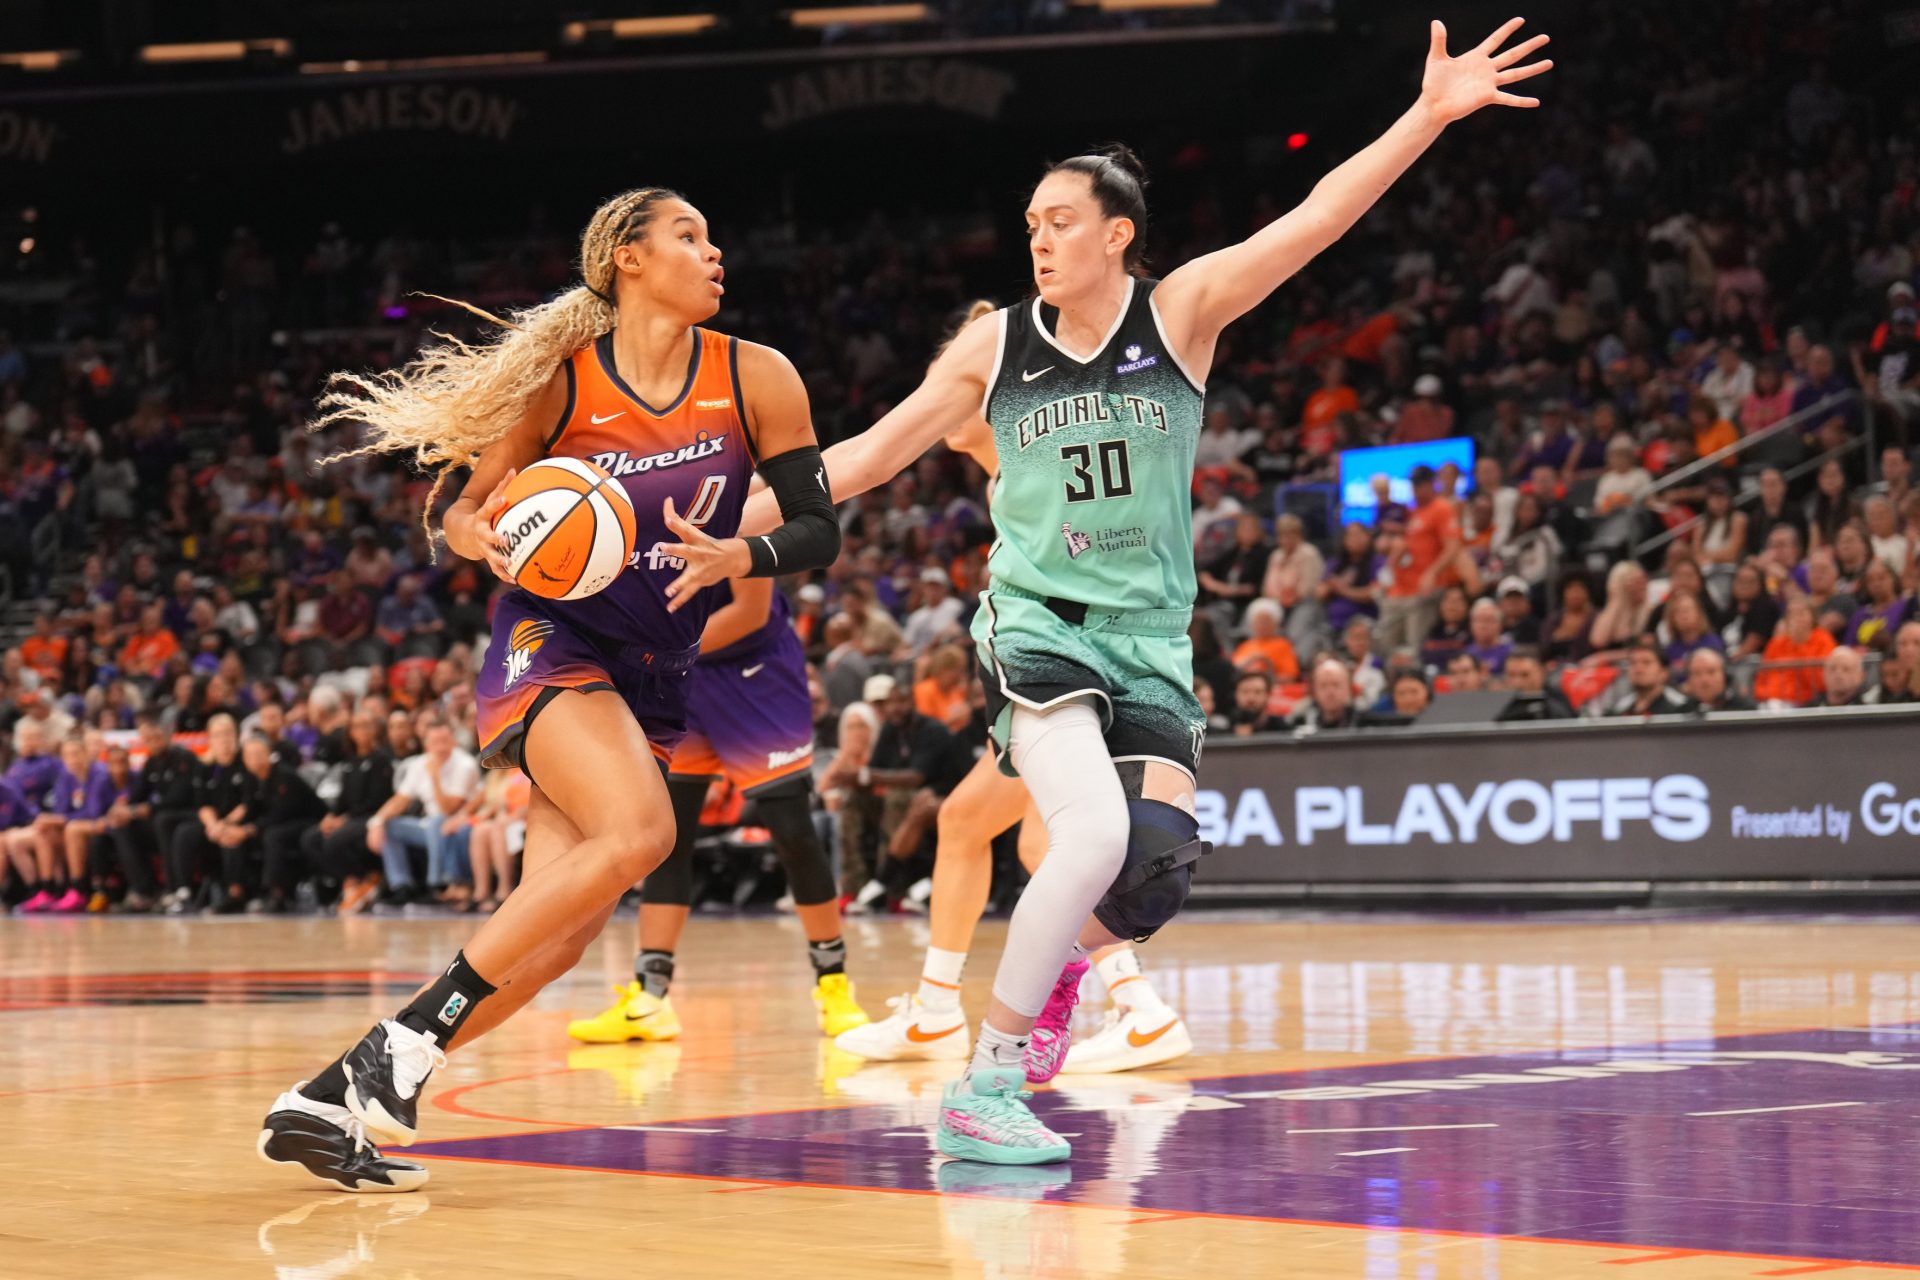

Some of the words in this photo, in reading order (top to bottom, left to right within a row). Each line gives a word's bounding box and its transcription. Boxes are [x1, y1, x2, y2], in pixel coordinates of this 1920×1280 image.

[281, 83, 517, 155] JAMESON
[1116, 356, 1156, 373] BARCLAYS
[590, 431, 728, 477] Phoenix
[1060, 438, 1133, 504] 30
[683, 474, 727, 528] 0
[1096, 526, 1145, 541] Liberty
[1098, 536, 1147, 553] Mutual
[1295, 773, 1711, 846] PLAYOFFS
[1731, 804, 1822, 839] Presented
[1826, 804, 1852, 843] by
